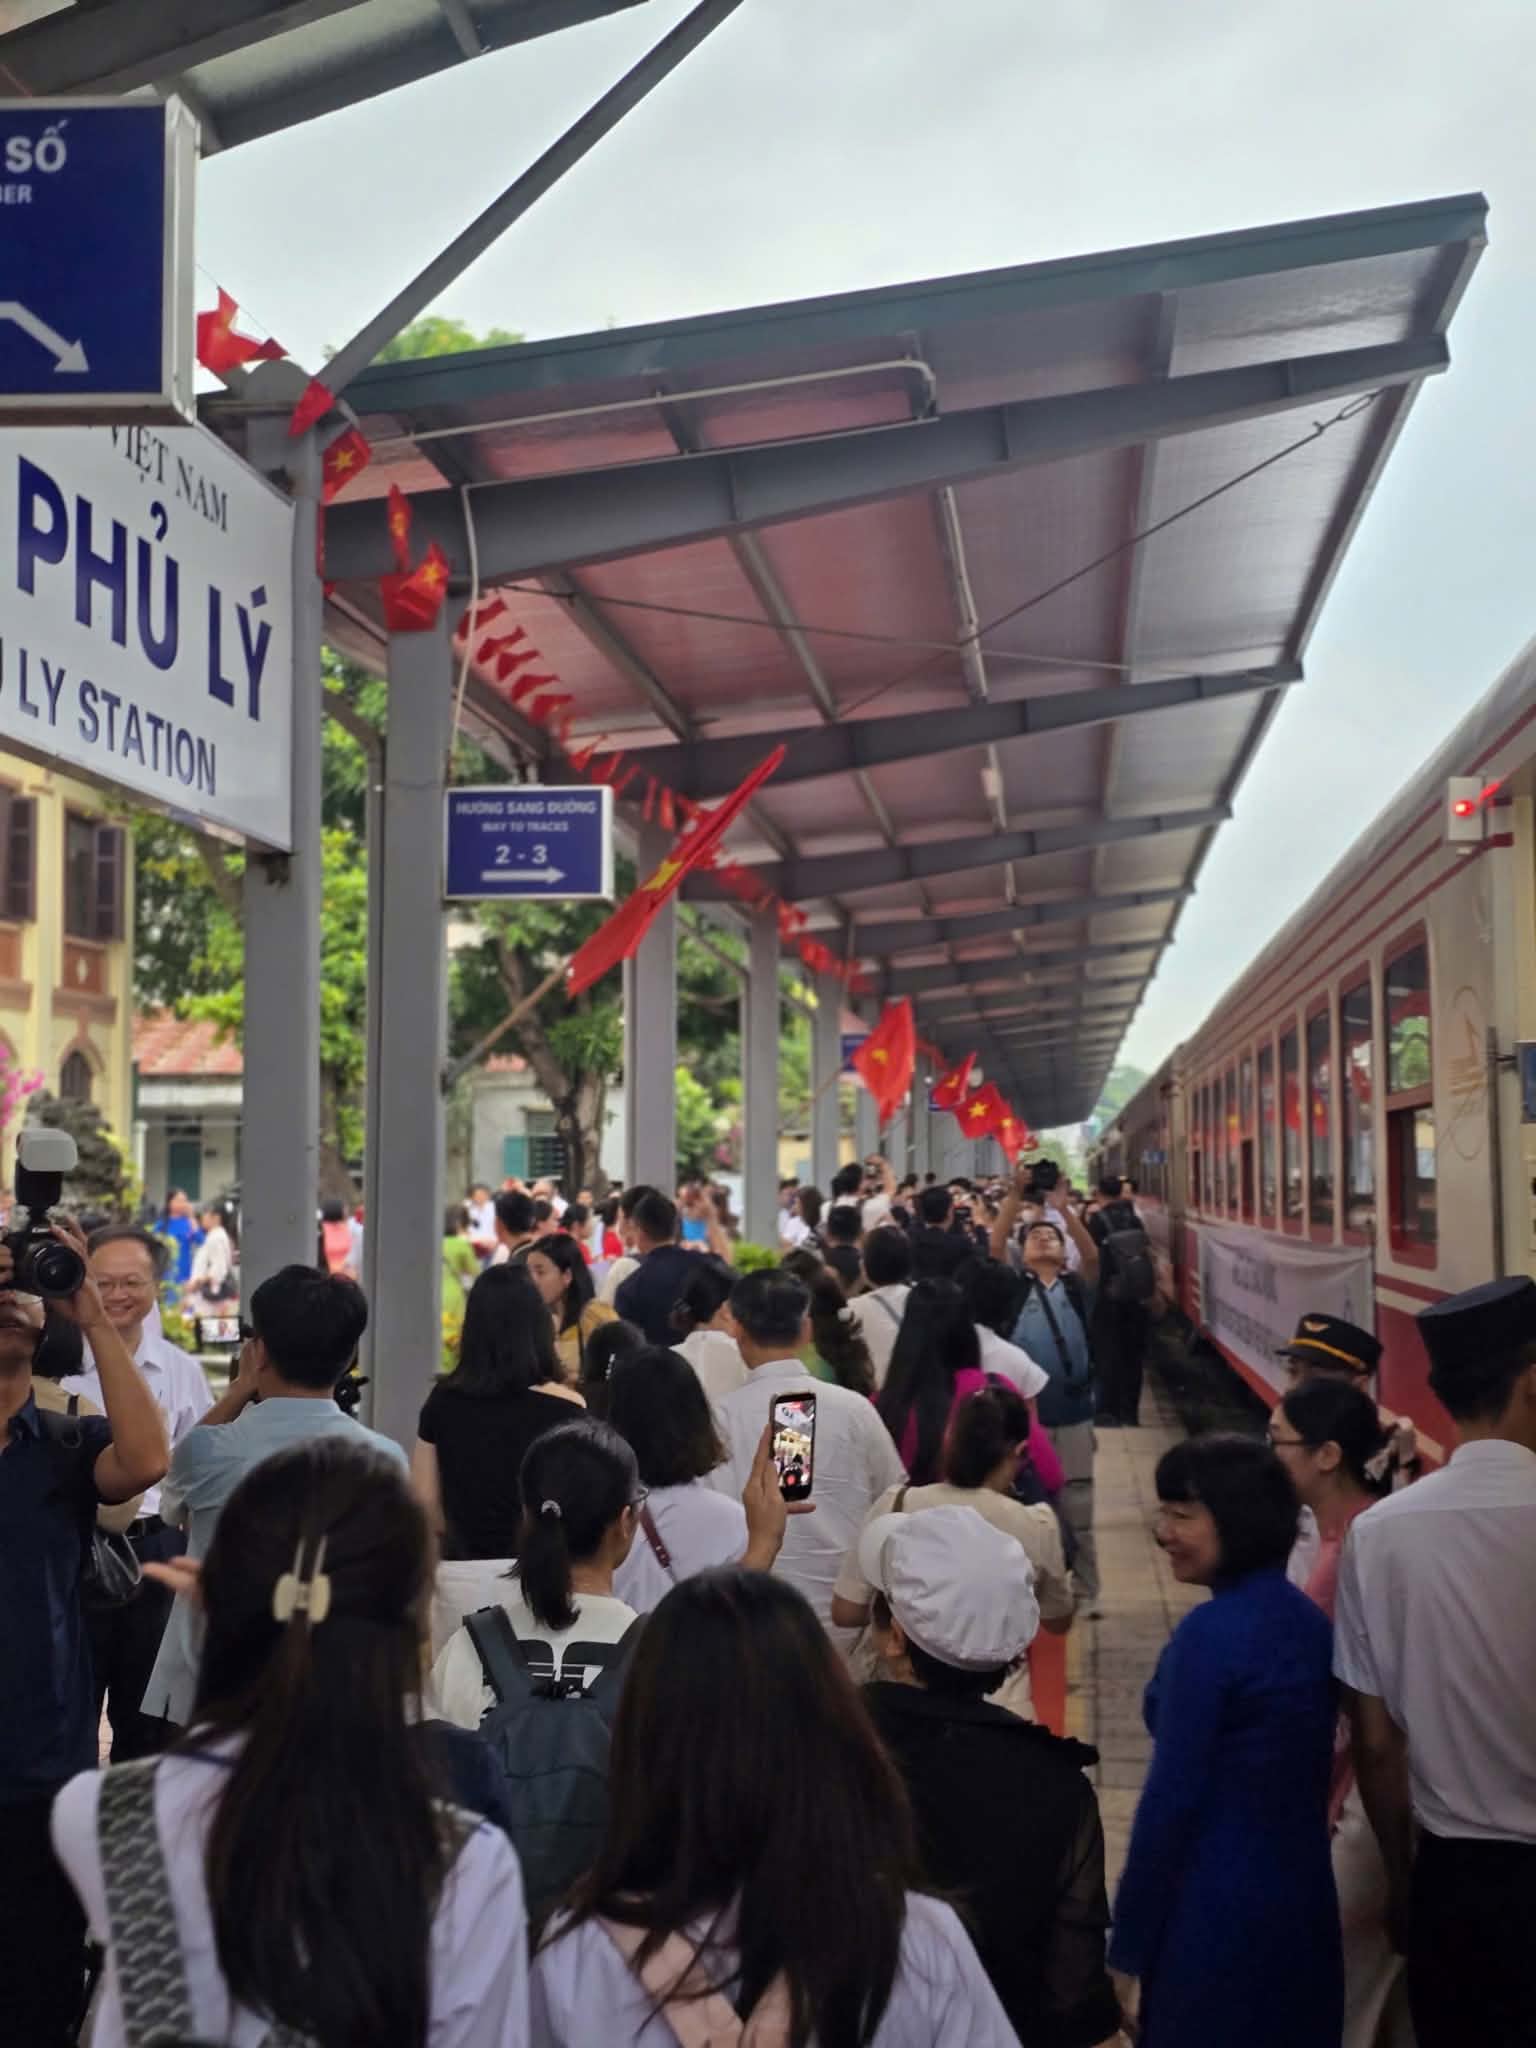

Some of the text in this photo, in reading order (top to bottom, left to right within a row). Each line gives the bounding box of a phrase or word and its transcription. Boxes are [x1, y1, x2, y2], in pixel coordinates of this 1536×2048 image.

[5, 119, 67, 174] SỐ
[0, 184, 32, 204] ER
[176, 456, 227, 532] NAM
[17, 454, 272, 722] PHỦ LÝ
[19, 648, 66, 726] LY
[78, 680, 215, 796] STATION
[481, 820, 569, 832] WAY TO TRACKS
[507, 801, 545, 814] SANG
[495, 844, 511, 864] 2
[531, 844, 548, 864] 3
